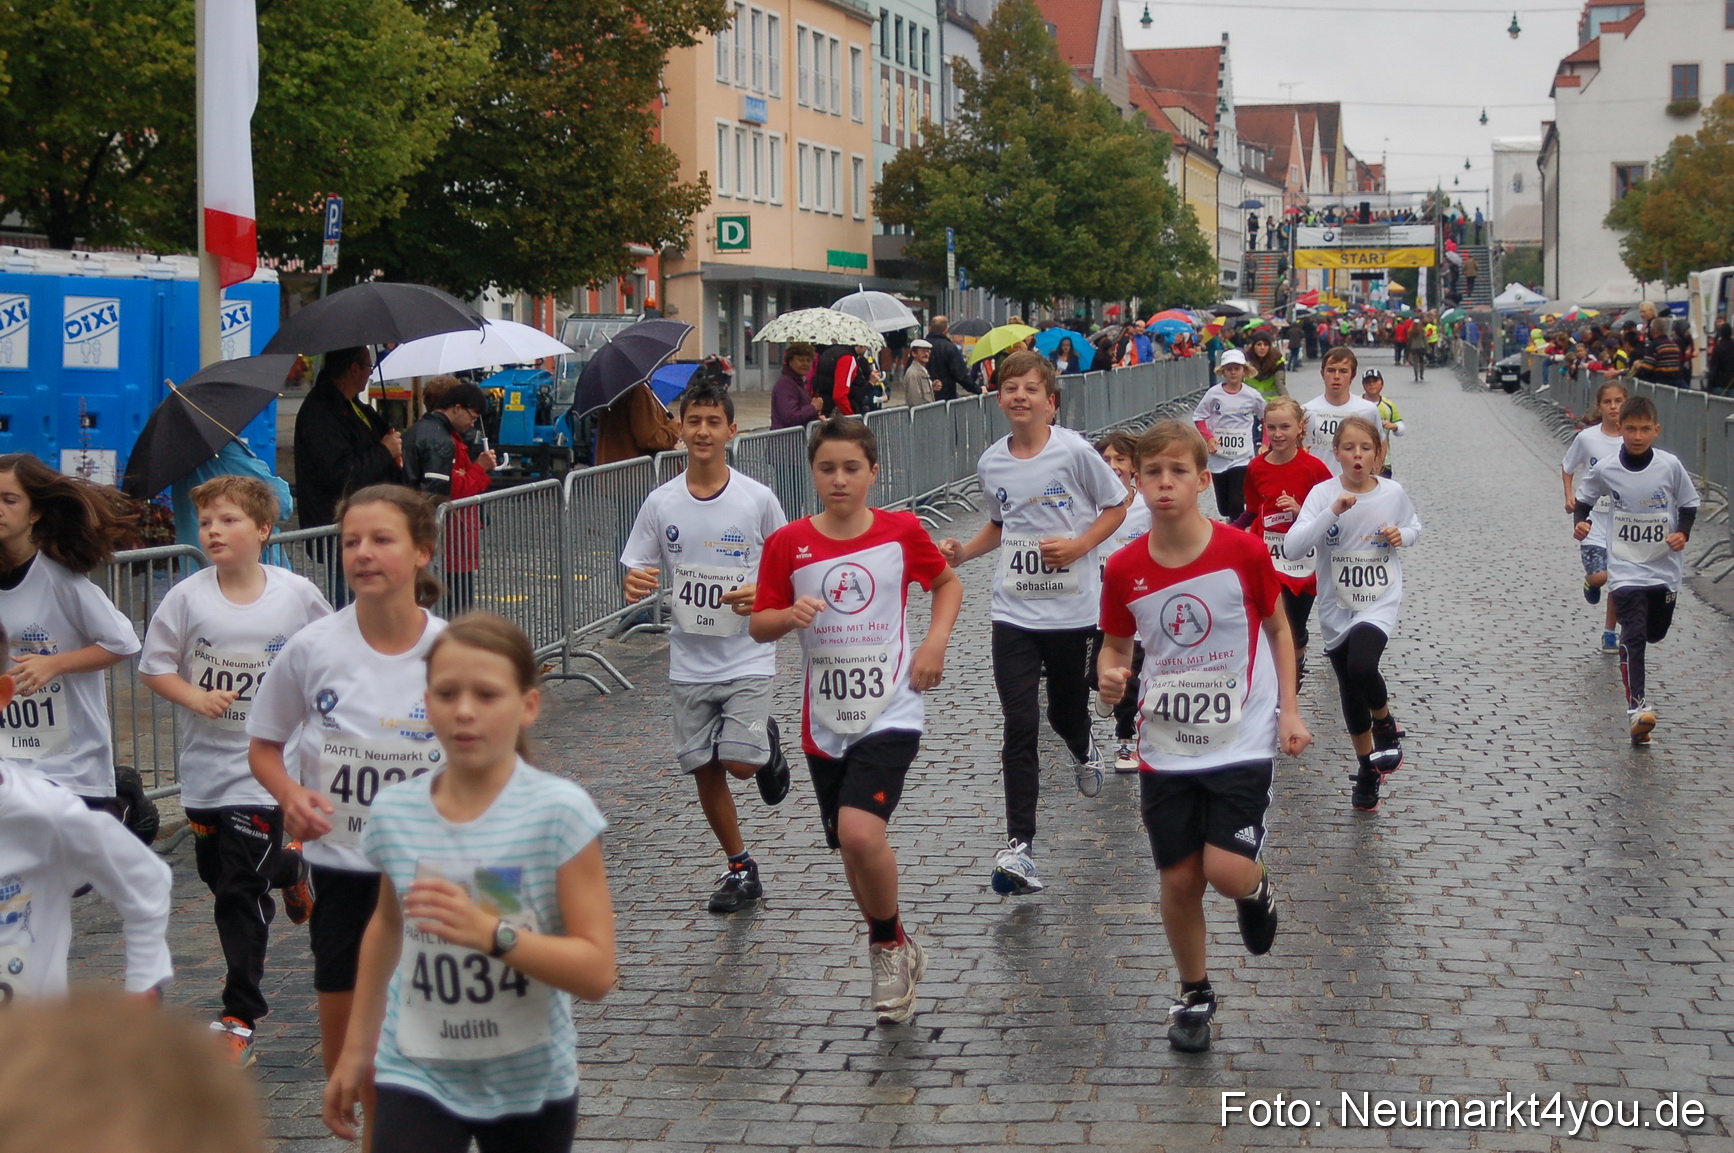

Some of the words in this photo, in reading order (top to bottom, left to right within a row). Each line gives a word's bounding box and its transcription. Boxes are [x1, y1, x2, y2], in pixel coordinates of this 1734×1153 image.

[721, 220, 745, 245] D
[1340, 253, 1388, 265] START
[1319, 420, 1339, 435] 40
[1217, 435, 1245, 448] 4003
[1618, 524, 1664, 543] 4048
[1005, 539, 1027, 548] PARTL
[1283, 563, 1304, 571] Laura
[675, 568, 697, 578] PARTL
[698, 572, 734, 581] Neumarkt
[1338, 565, 1389, 588] 4009
[1016, 580, 1064, 591] Sebastian
[1352, 593, 1376, 603] Marie
[696, 614, 715, 626] Can
[846, 624, 864, 632] MIT
[868, 621, 889, 631] HERZ
[194, 649, 220, 666] PARTL
[222, 659, 265, 669] Neumarkt
[812, 657, 833, 666] PARTL
[834, 655, 876, 664] Neumarkt
[1187, 655, 1205, 665] MIT
[1208, 649, 1235, 661] HERZ
[819, 667, 885, 701] 4033
[1178, 679, 1223, 689] Neumarkt
[220, 708, 246, 720] lias
[1153, 692, 1231, 724] 4029
[836, 709, 867, 721] Jonas
[11, 736, 41, 748] Linda
[1175, 730, 1210, 745] Jonas
[324, 743, 362, 759] PARTL
[364, 751, 423, 761] Neumarkt
[1234, 832, 1257, 846] adidas
[411, 951, 530, 1006] 4034
[439, 1018, 499, 1040] Judith
